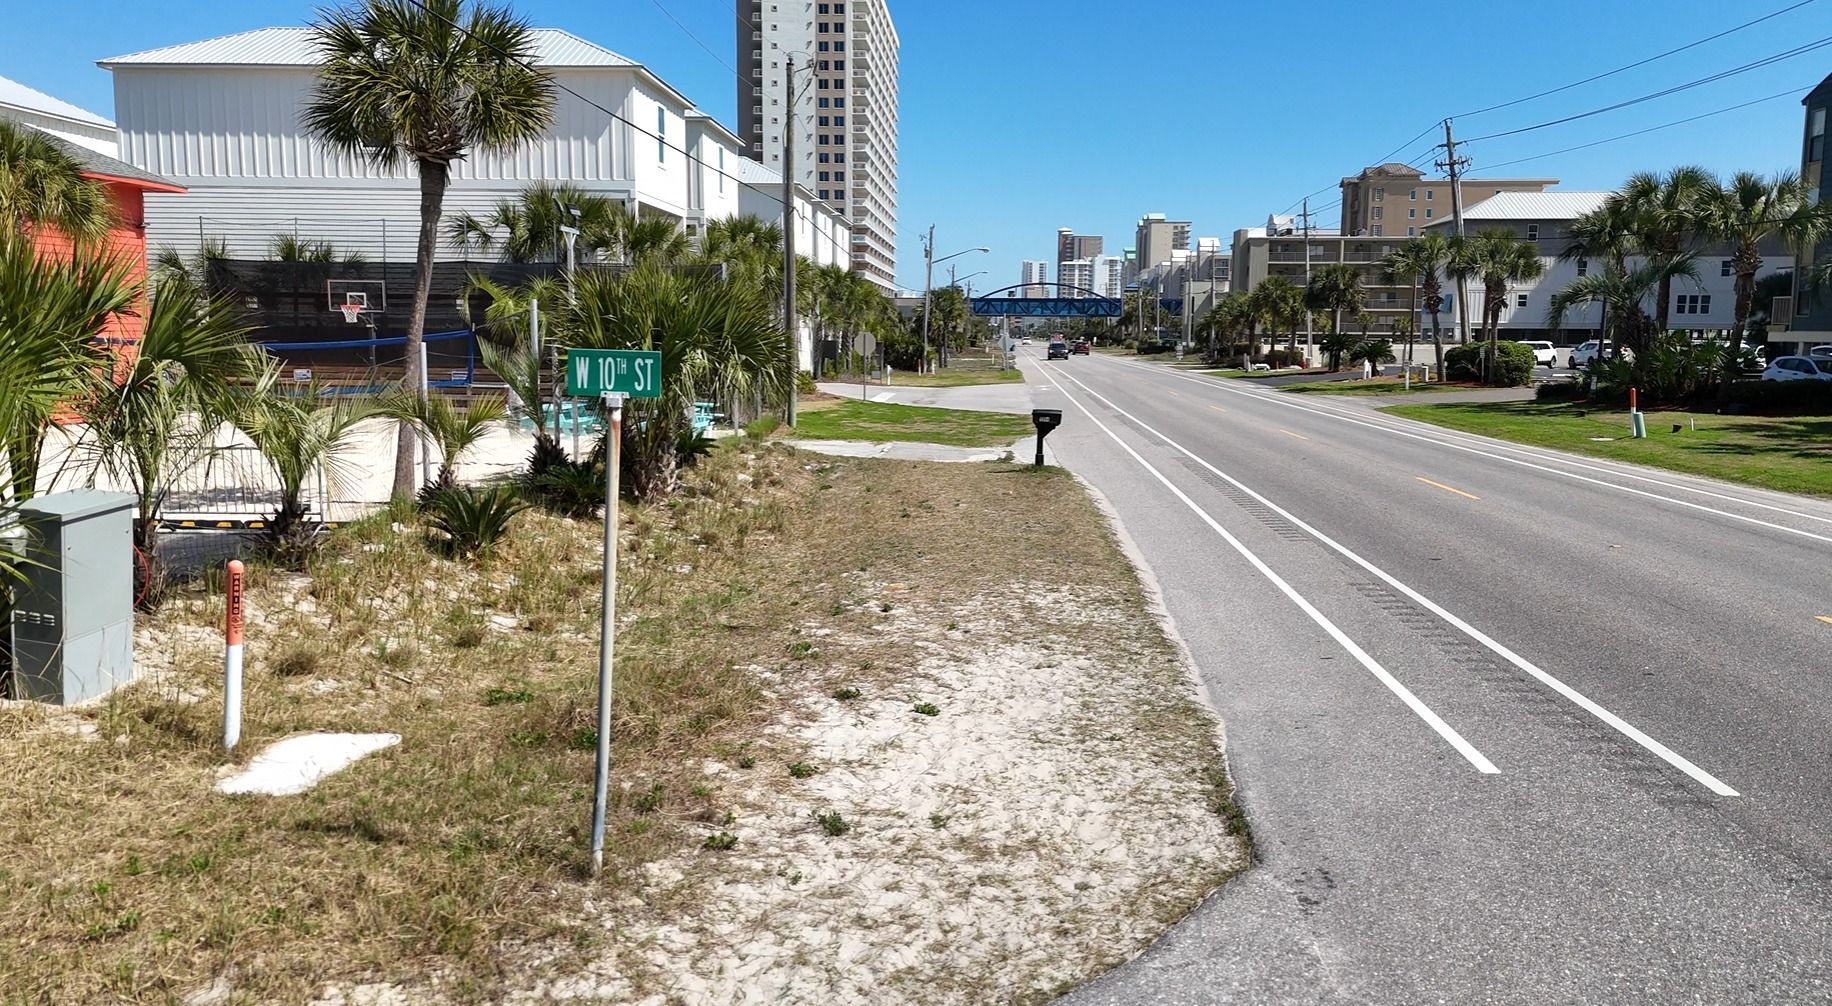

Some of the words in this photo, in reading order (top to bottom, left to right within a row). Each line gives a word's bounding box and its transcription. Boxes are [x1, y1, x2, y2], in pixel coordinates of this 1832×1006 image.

[575, 356, 590, 389] W
[598, 357, 627, 390] 10TH
[634, 358, 654, 391] ST
